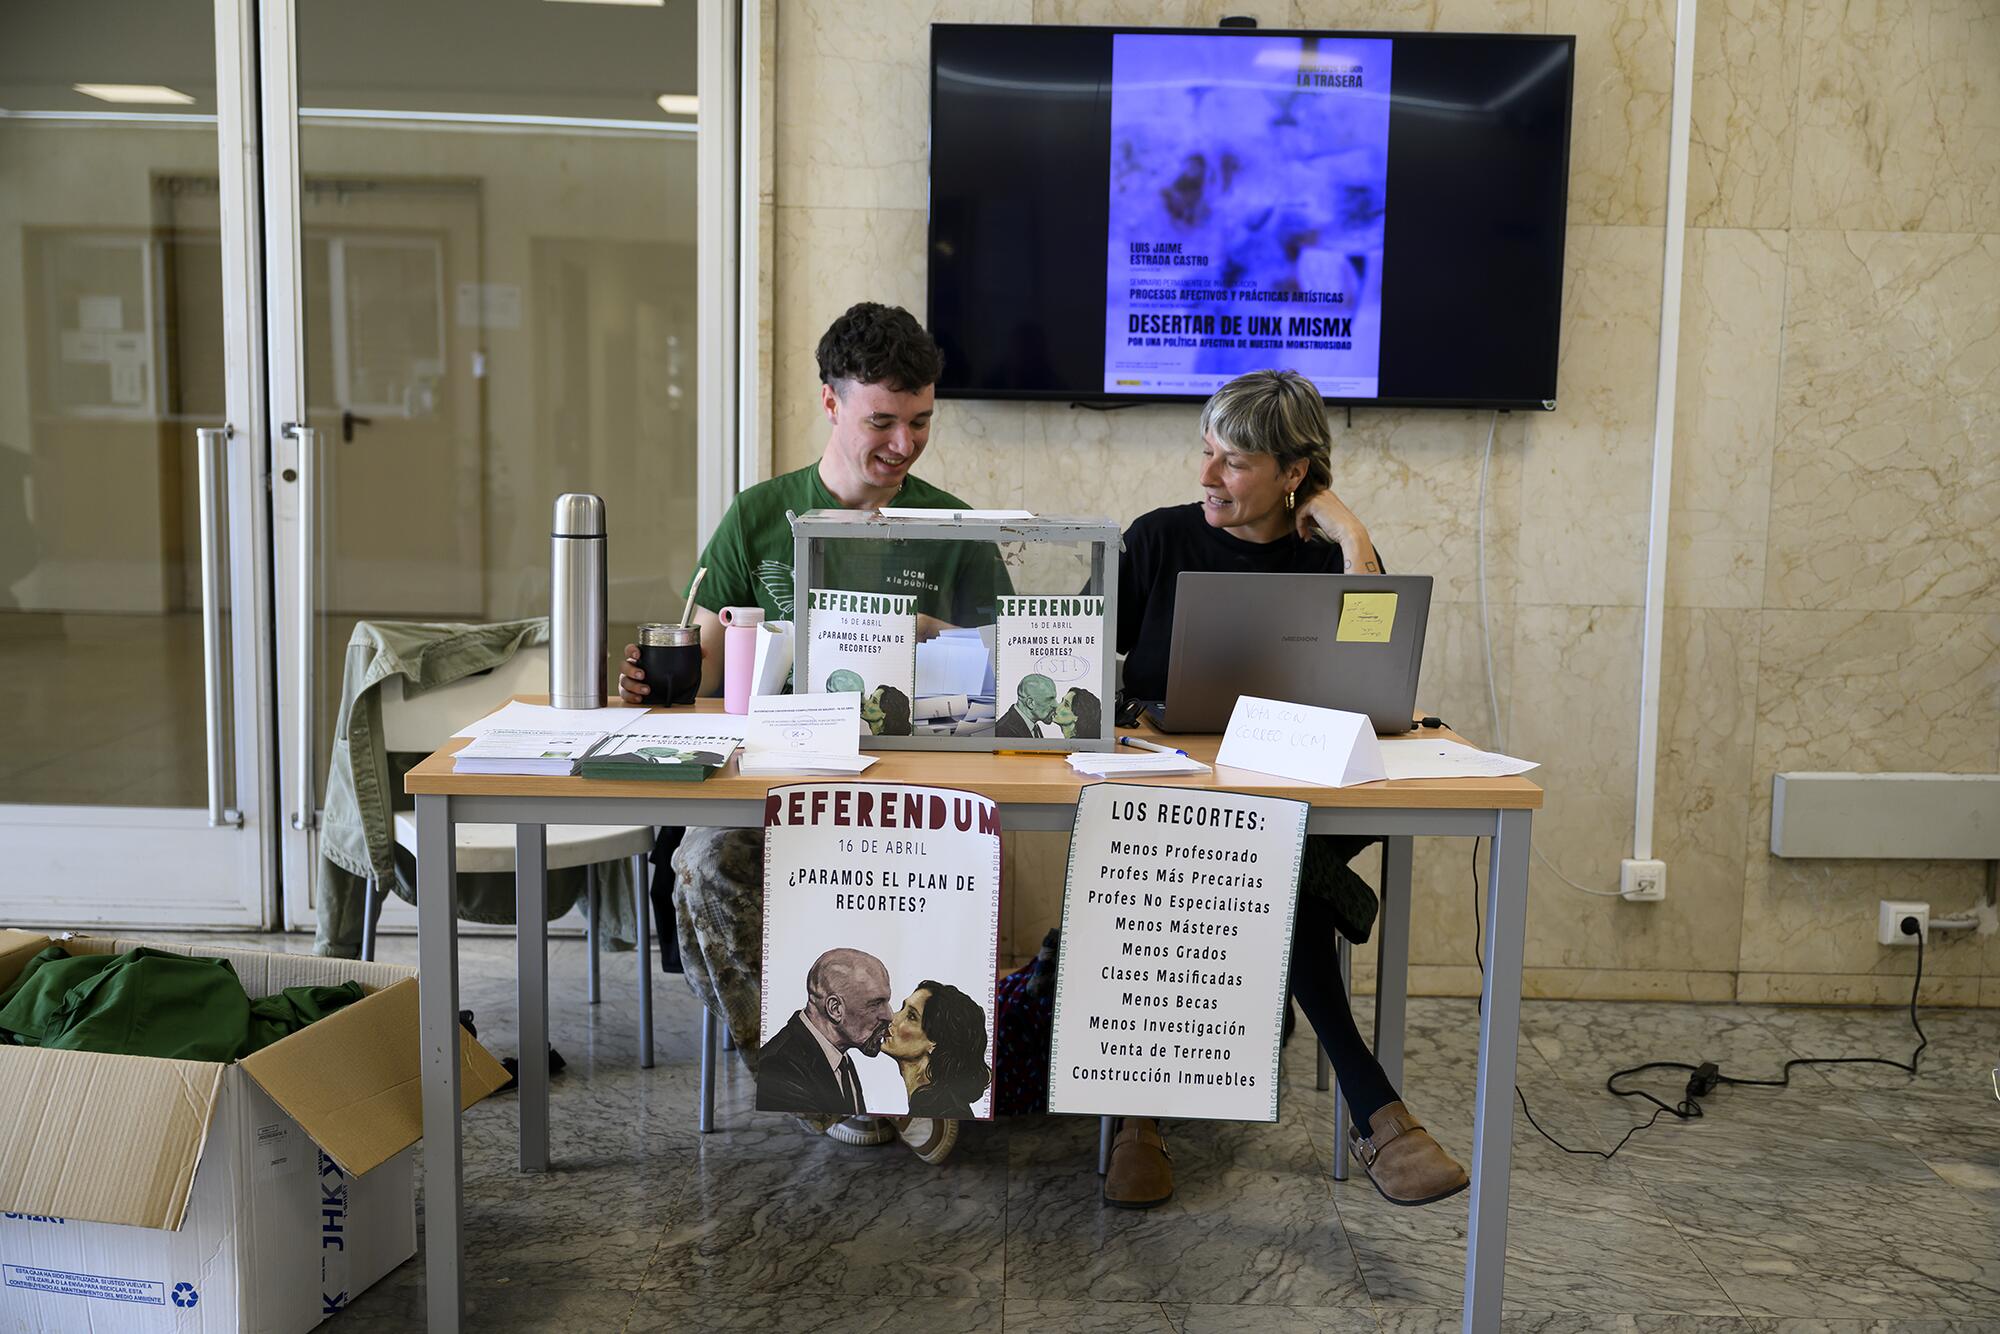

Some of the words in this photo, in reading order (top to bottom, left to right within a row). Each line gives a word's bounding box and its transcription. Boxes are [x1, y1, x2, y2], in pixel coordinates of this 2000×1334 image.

[1314, 74, 1362, 88] TRASERA
[1130, 242, 1150, 254] LUIS
[1153, 242, 1182, 254] JAIME
[1130, 255, 1170, 266] ESTRADA
[1173, 255, 1208, 266] CASTRO
[1130, 289, 1177, 300] PROCESOS
[1180, 289, 1228, 301] AFECTIVOS
[1230, 290, 1237, 301] Y
[1239, 288, 1289, 302] PRÁCTICAS
[1291, 289, 1344, 303] ARTÍSTICAS
[1129, 314, 1215, 335] DESERTAR
[1221, 315, 1242, 335] DE
[1248, 316, 1282, 336] UNX
[1289, 317, 1352, 337] MISMX
[1128, 337, 1143, 346] POR
[1145, 337, 1161, 346] UNA
[1163, 336, 1197, 347] POLÍTICA
[1199, 338, 1235, 348] AFECTIVA
[1237, 339, 1247, 348] DE
[1250, 340, 1283, 349] NUESTRA
[1286, 340, 1352, 350] MONSTRUOSIDAD
[893, 576, 901, 584] la
[903, 578, 939, 592] pública
[903, 569, 925, 580] UCM
[808, 592, 918, 616] REFERENDUM
[841, 617, 848, 625] 16
[851, 618, 860, 626] DE
[862, 618, 882, 627] ABRIL
[818, 630, 857, 642] ¿PARAMOS
[860, 633, 869, 642] EL
[872, 634, 892, 643] PLAN
[895, 635, 904, 643] DE
[1008, 636, 1048, 646] ¿PARAMOS
[1051, 636, 1060, 645] EL
[1063, 636, 1082, 645] PLAN
[1085, 636, 1095, 645] DE
[839, 643, 882, 654] RECORTES?
[1030, 648, 1073, 656] RECORTES?
[765, 791, 1000, 836] REFERENDUM
[1111, 800, 1147, 822] LOS
[1158, 803, 1266, 831] RECORTES:
[839, 839, 854, 853] 16
[861, 839, 878, 853] DE
[886, 840, 927, 856] ABRIL
[1110, 840, 1158, 857] Menos
[1165, 844, 1258, 863] Profesorado
[788, 868, 873, 888] ¿PARAMOS
[882, 871, 899, 887] EL
[908, 872, 947, 890] PLAN
[956, 875, 975, 891] DE
[1100, 865, 1149, 881] Profes
[1156, 868, 1184, 884] Más
[1192, 871, 1263, 889] Precarias
[836, 894, 926, 912] RECORTES?
[1088, 890, 1136, 907] Profes
[1144, 893, 1162, 908] No
[1170, 894, 1271, 914] Especialistas
[1115, 916, 1162, 933] Menos
[1170, 919, 1239, 937] Másteres
[1122, 942, 1169, 958] Menos
[1176, 945, 1227, 961] Grados
[1101, 966, 1149, 982] Clases
[1156, 969, 1243, 987] Masificadas
[1122, 992, 1169, 1008] Menos
[1176, 995, 1218, 1011] Becas
[1089, 1016, 1137, 1032] Menos
[1143, 1018, 1246, 1038] Investigación
[1100, 1041, 1143, 1057] Venta
[1150, 1042, 1167, 1058] de
[1173, 1044, 1231, 1061] Terreno
[1072, 1066, 1171, 1084] Construcción
[1179, 1070, 1256, 1087] Inmuebles
[322, 1183, 344, 1252] JHK
[25, 1276, 55, 1284] UTILIZARLA
[126, 1281, 146, 1289] VUELVE
[9, 1280, 53, 1290] CONTRIBUYENDO
[61, 1287, 103, 1296] MANTENIMIENTO
[134, 1295, 161, 1303] AMBIENTE
